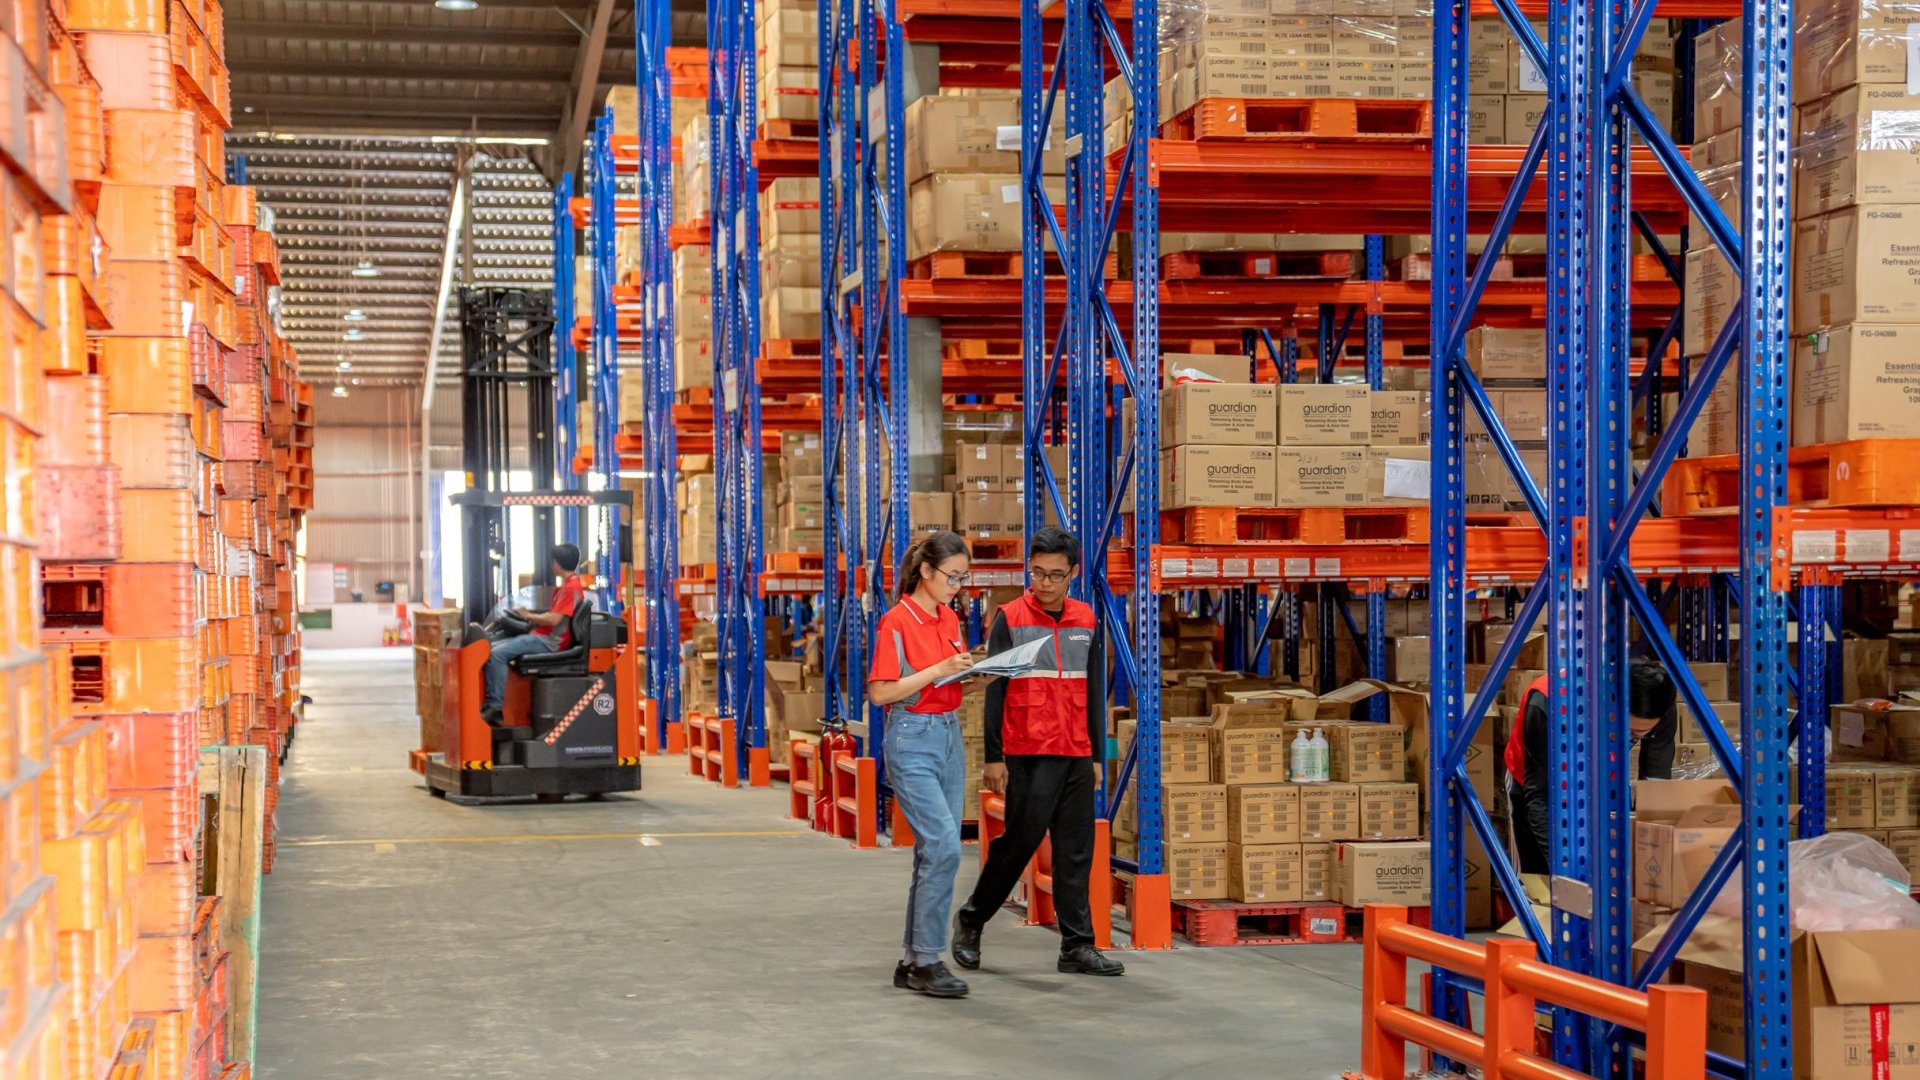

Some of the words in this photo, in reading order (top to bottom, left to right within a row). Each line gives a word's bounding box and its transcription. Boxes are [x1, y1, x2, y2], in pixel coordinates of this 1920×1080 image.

[1208, 402, 1256, 414] guardian
[1303, 403, 1351, 416] guardian
[1371, 409, 1400, 419] ardian
[1207, 464, 1256, 476] guardian
[1298, 465, 1346, 477] guardian
[598, 700, 610, 708] R2
[1376, 865, 1423, 877] guardian
